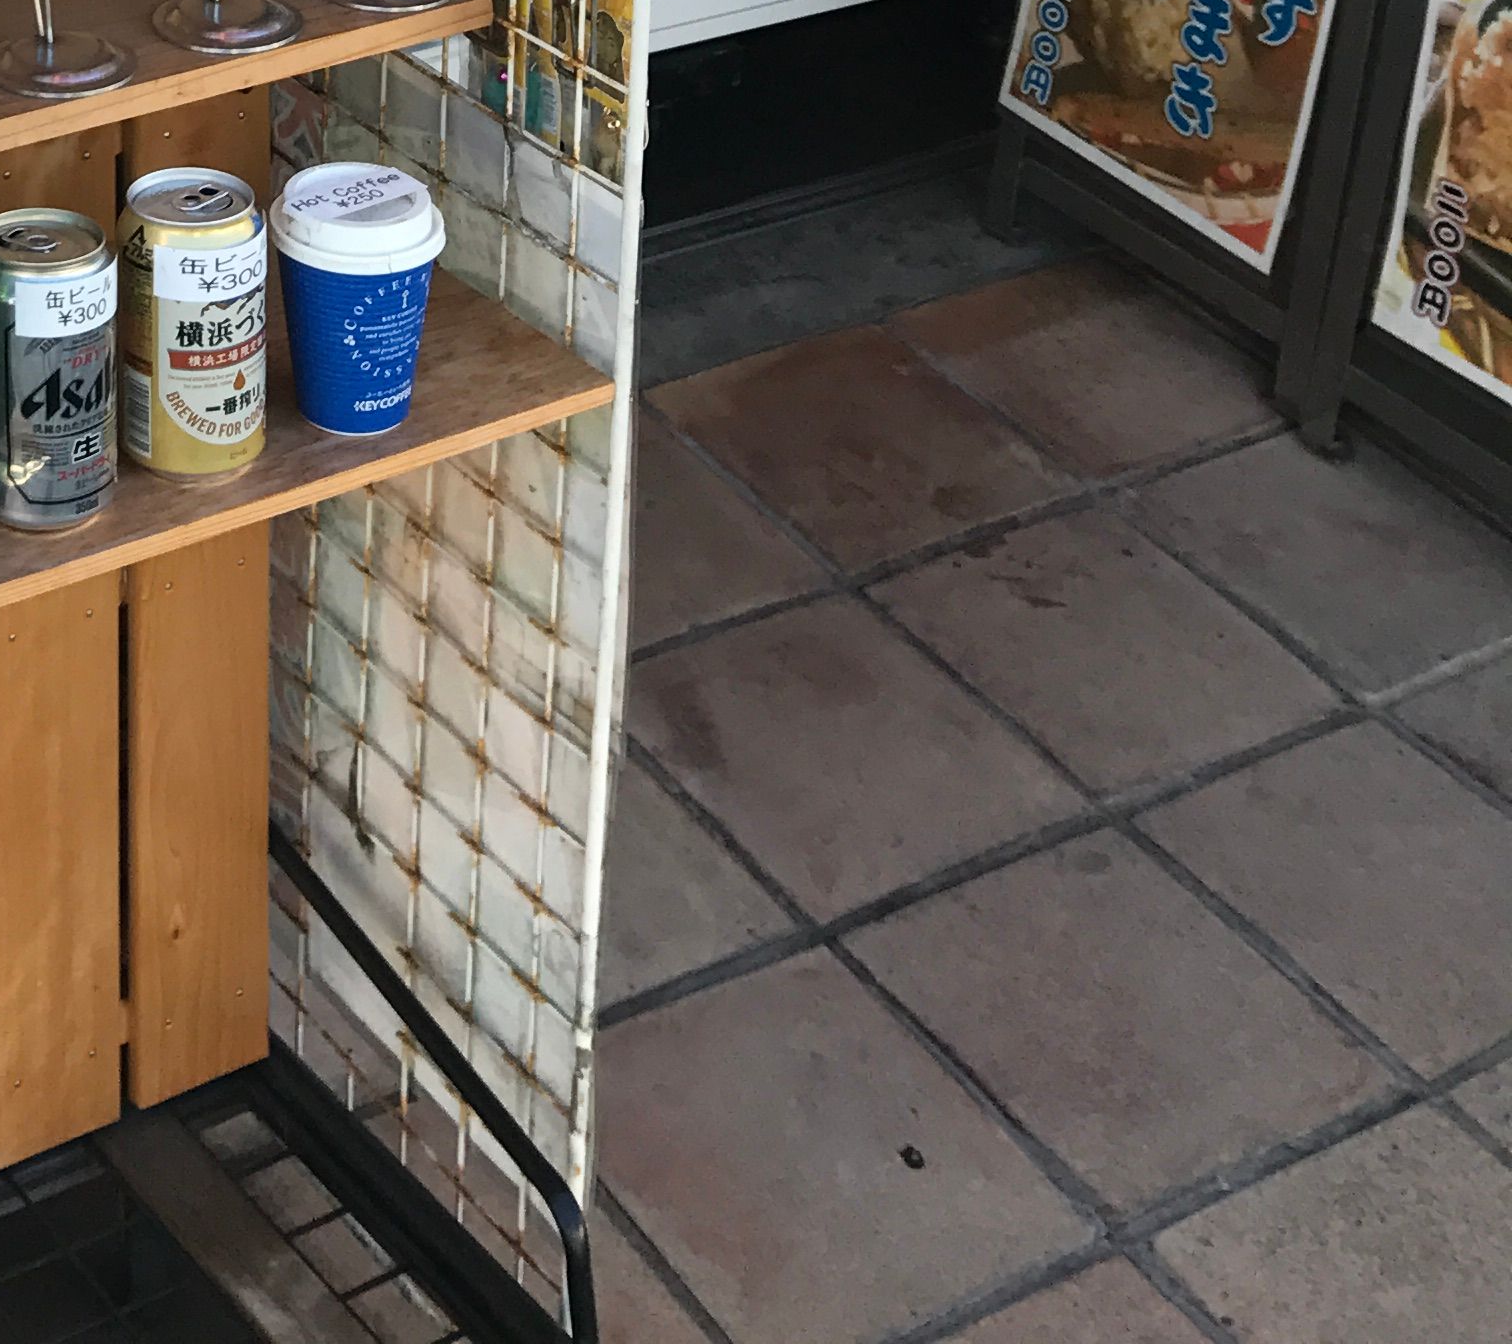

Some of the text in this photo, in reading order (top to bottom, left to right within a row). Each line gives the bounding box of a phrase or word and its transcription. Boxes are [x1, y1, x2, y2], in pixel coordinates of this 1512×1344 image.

[290, 171, 402, 213] Hot Coffee
[335, 187, 385, 210] ¥250
[44, 274, 112, 311] 缶ビール
[196, 261, 264, 293] ¥300
[58, 297, 108, 327] ¥300
[165, 390, 217, 437] BREWED
[218, 420, 242, 438] FOR
[73, 432, 102, 463] 生
